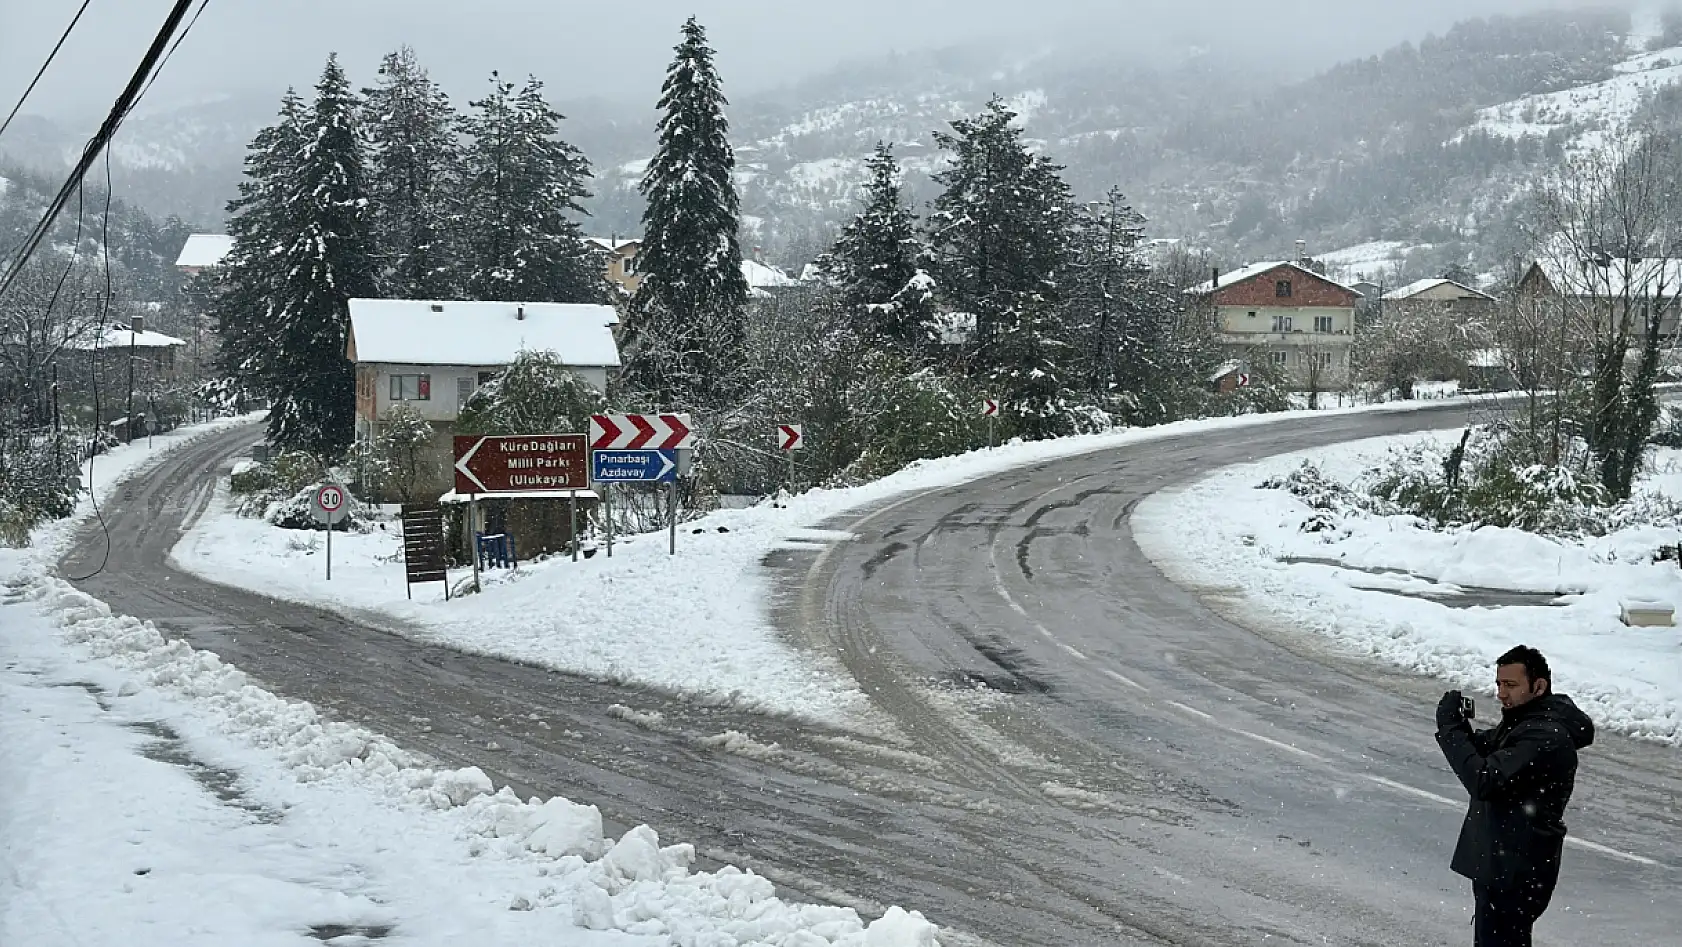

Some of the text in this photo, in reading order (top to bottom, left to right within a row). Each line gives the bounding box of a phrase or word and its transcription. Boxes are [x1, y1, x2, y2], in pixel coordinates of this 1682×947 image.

[508, 457, 570, 468] Milli Parkı
[600, 453, 650, 465] Pınarbaşı
[600, 467, 646, 479] Azdavay
[509, 474, 570, 486] (Ulukaya)
[323, 493, 338, 505] 30
